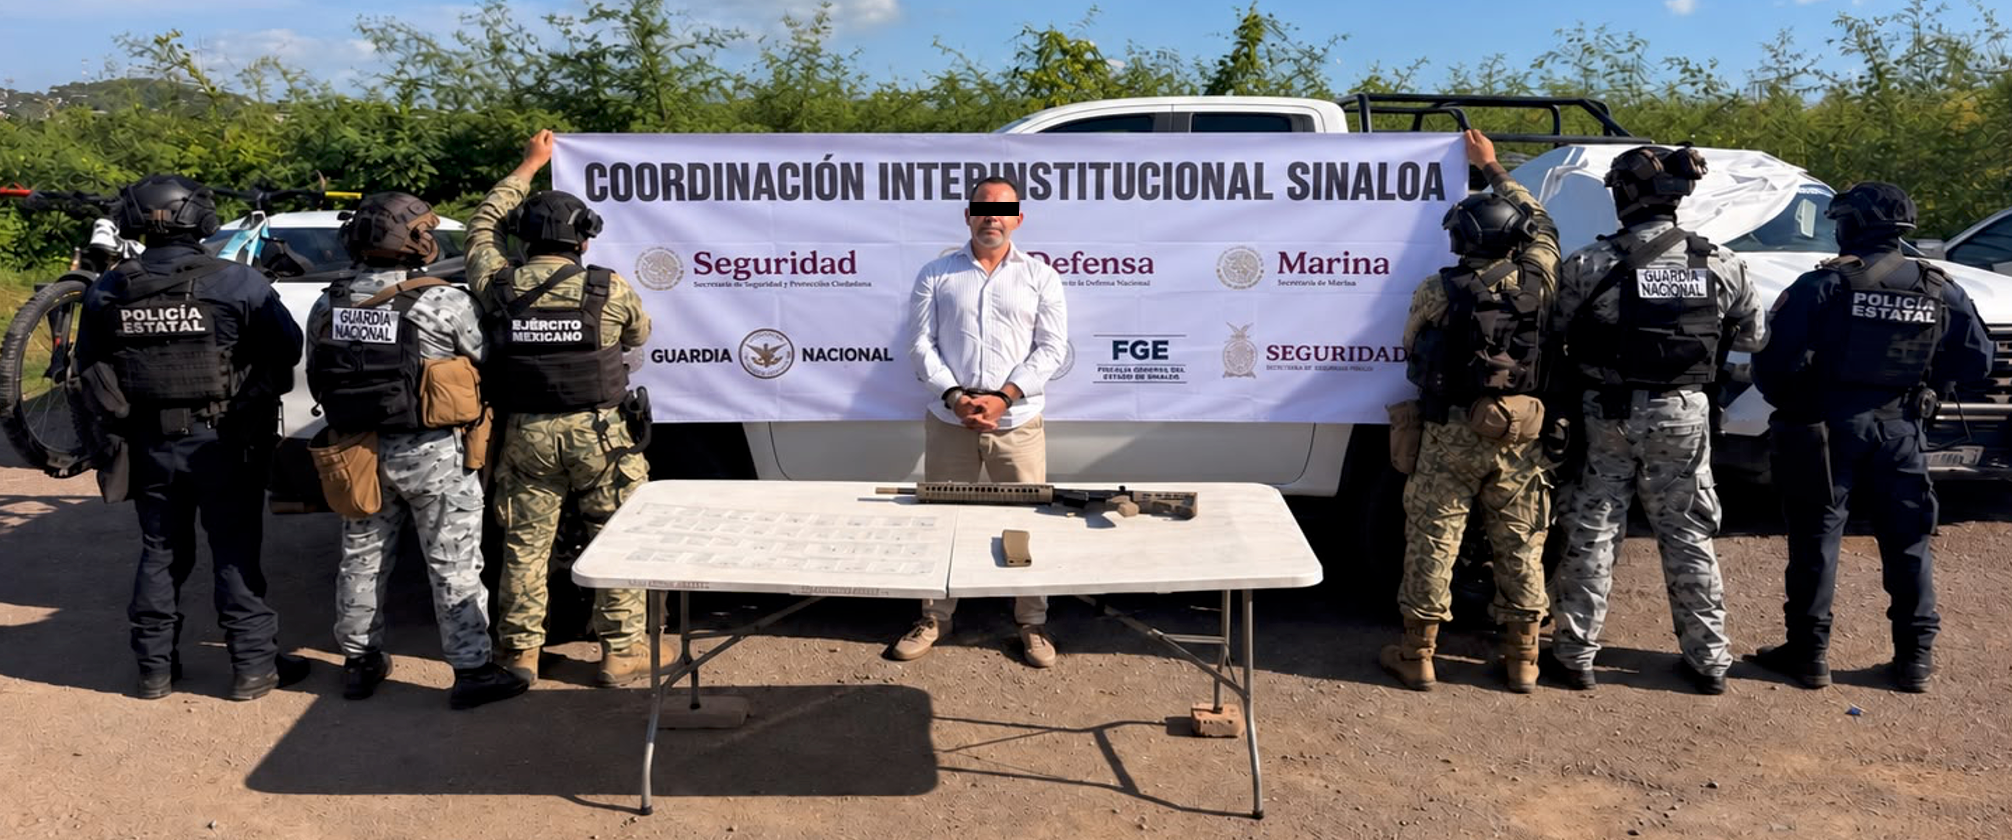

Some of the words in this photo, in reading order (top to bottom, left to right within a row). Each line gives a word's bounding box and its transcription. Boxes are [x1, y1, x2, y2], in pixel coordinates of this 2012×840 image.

[585, 154, 864, 202] COORDINACIÓN
[1287, 161, 1446, 201] SINALOA
[693, 250, 857, 281] Seguridad
[1277, 250, 1391, 275] Marina
[1643, 269, 1700, 283] GUARDIA
[1640, 282, 1706, 297] NACIONAL
[1853, 291, 1936, 311] POLICÍA
[120, 304, 203, 322] POLICÍA
[340, 309, 392, 327] GUARDIA
[1851, 305, 1937, 323] ESTATAL
[122, 319, 206, 334] ESTATAL
[335, 324, 392, 342] NACIONAL
[512, 317, 582, 331] EJÉRCITO
[512, 331, 583, 342] MEXICANO
[651, 348, 733, 363] GUARDIA
[802, 346, 894, 362] NACIONAL
[1111, 339, 1170, 361] FGE
[1266, 344, 1408, 363] SEGURIDAD
